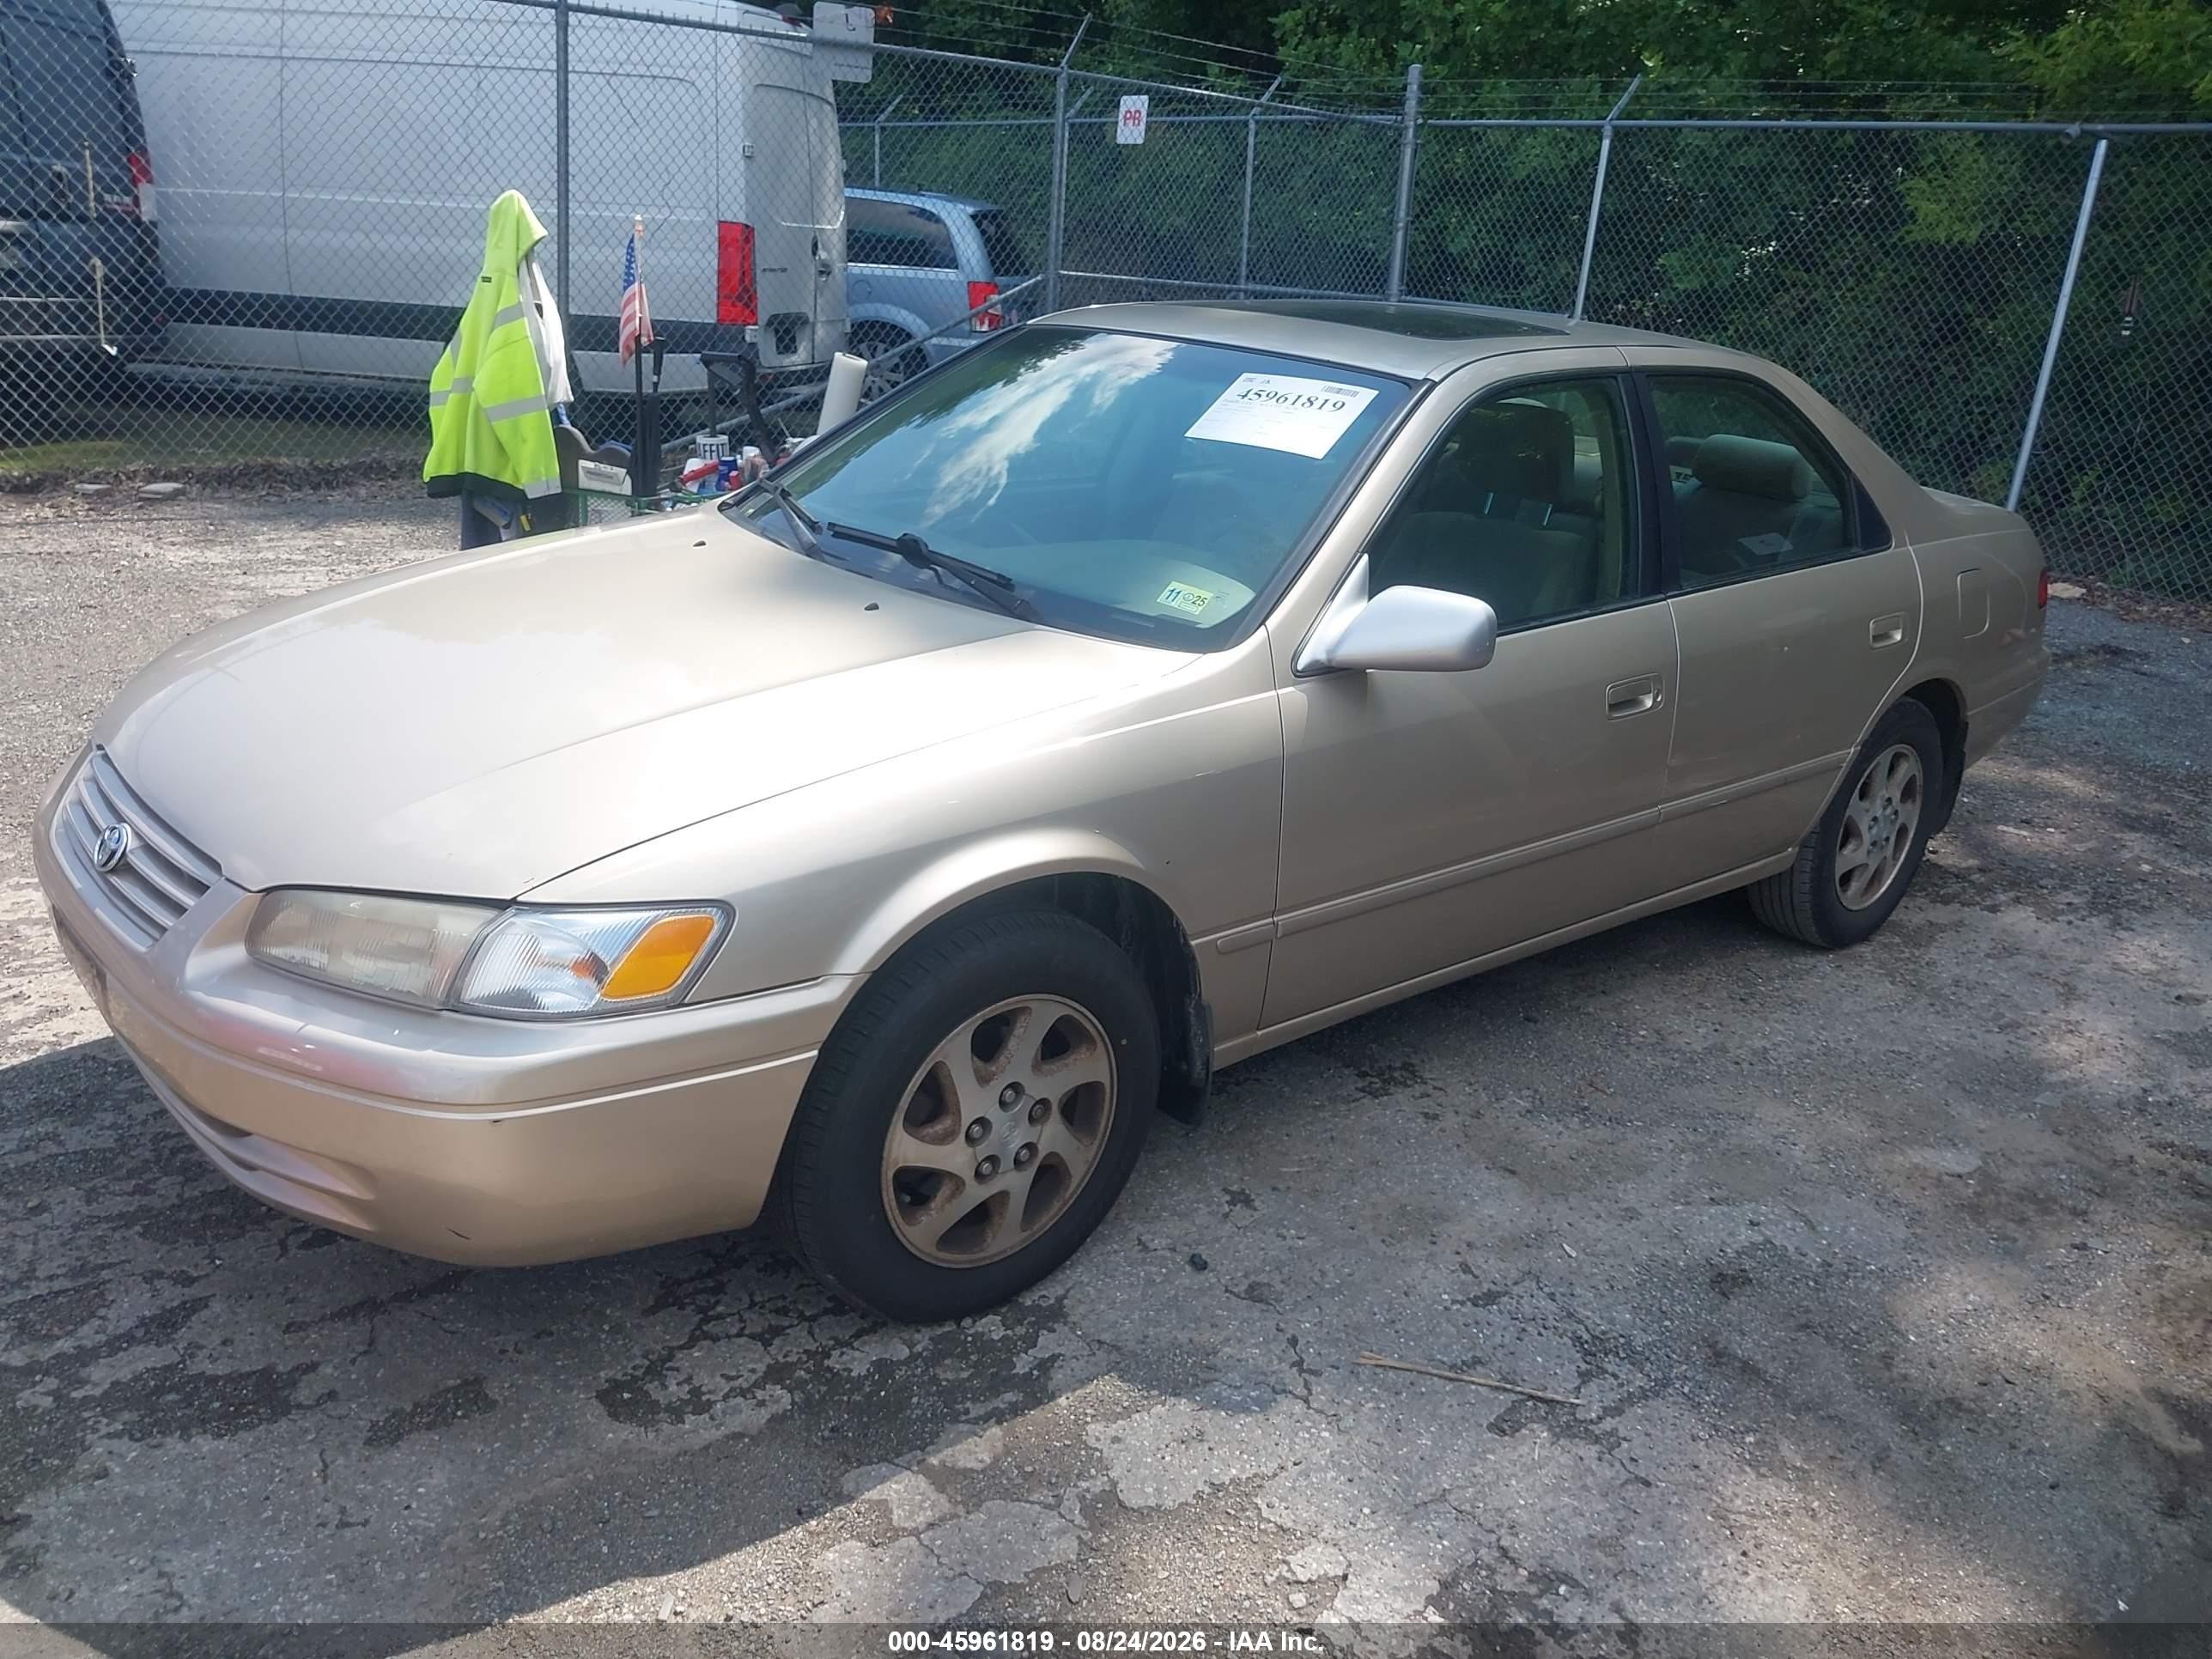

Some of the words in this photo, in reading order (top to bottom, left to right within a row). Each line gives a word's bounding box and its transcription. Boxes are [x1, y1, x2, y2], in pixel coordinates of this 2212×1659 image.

[1237, 387, 1346, 413] 45961819
[1165, 587, 1182, 602] 11
[1191, 595, 1208, 607] 25
